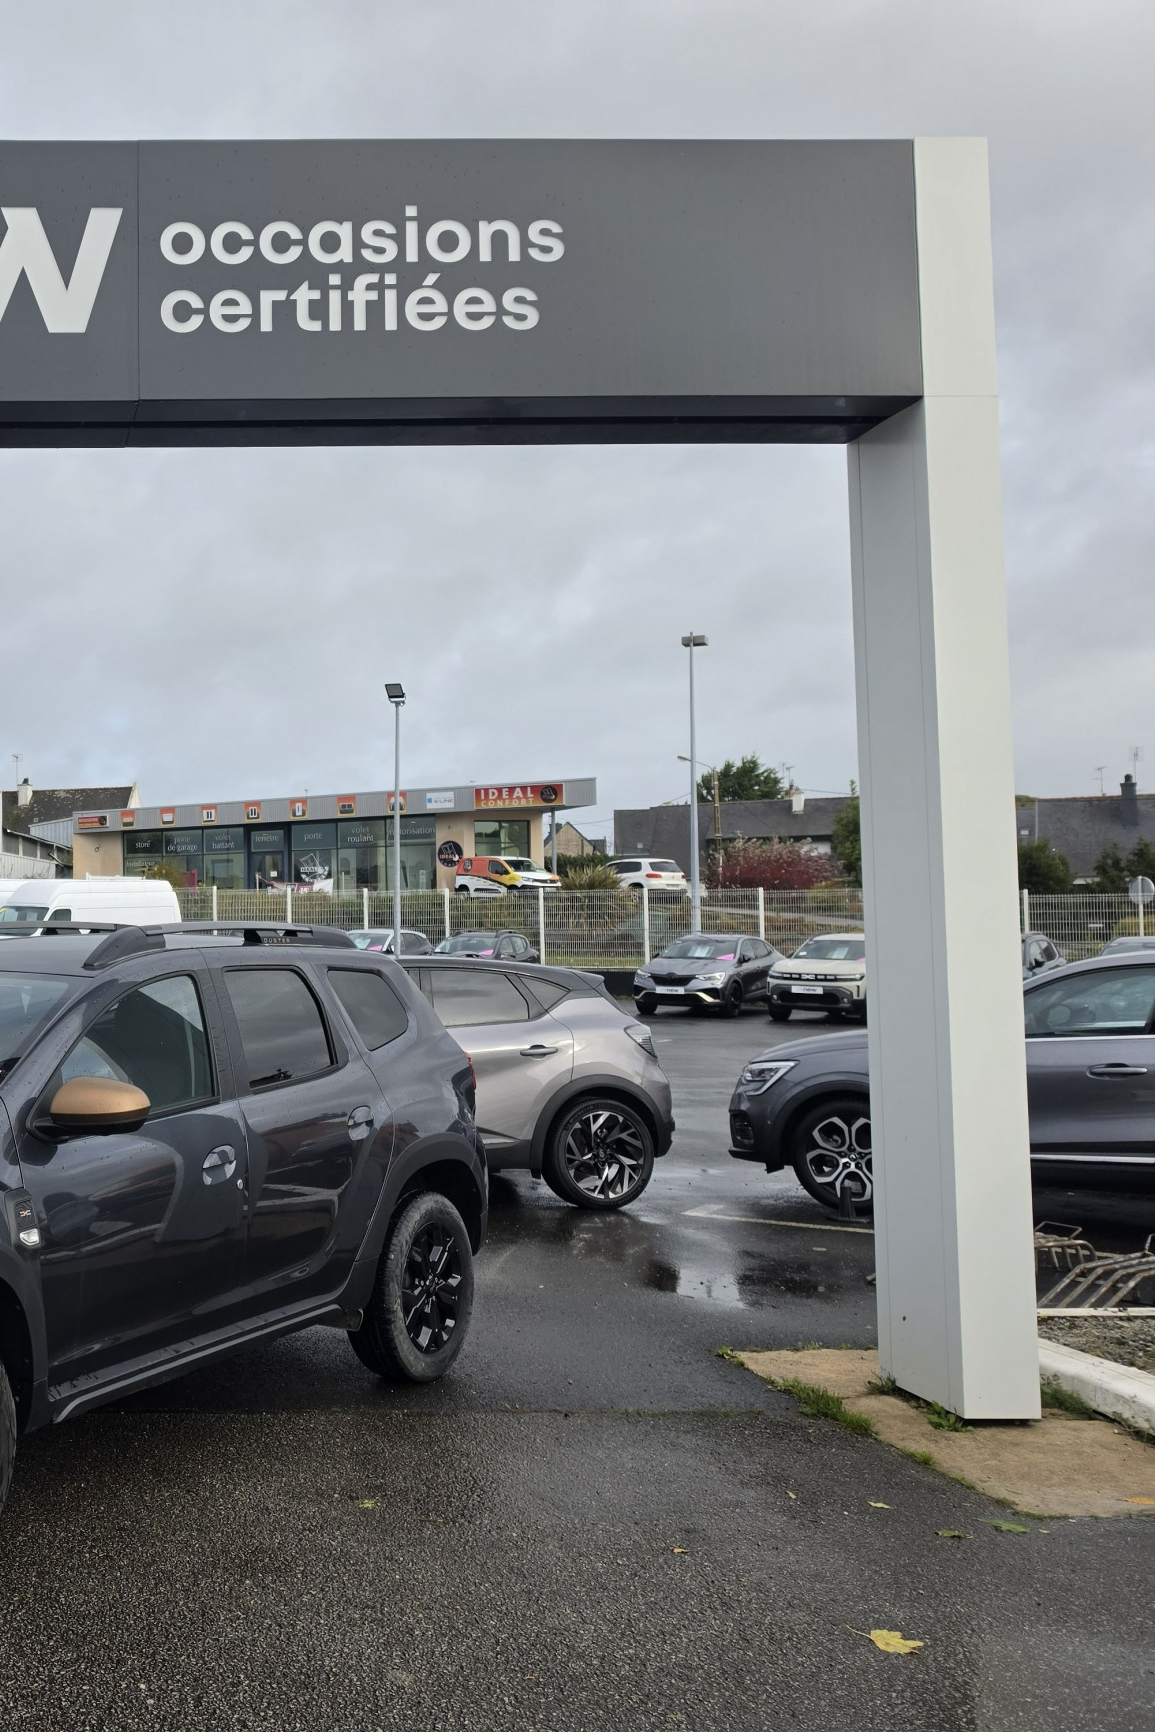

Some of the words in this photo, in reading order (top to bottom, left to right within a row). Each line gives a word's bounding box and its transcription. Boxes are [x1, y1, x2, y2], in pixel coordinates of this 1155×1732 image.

[159, 204, 566, 265] occasions
[160, 272, 540, 333] certifiées
[480, 786, 534, 800] IDEAL
[481, 798, 534, 808] CONFORT
[351, 825, 370, 833] volet
[174, 835, 191, 843] porte
[304, 831, 323, 842] porte
[347, 834, 374, 843] roulant
[135, 841, 151, 849] store
[167, 843, 176, 851] de
[176, 843, 197, 853] garage
[212, 841, 235, 850] battant
